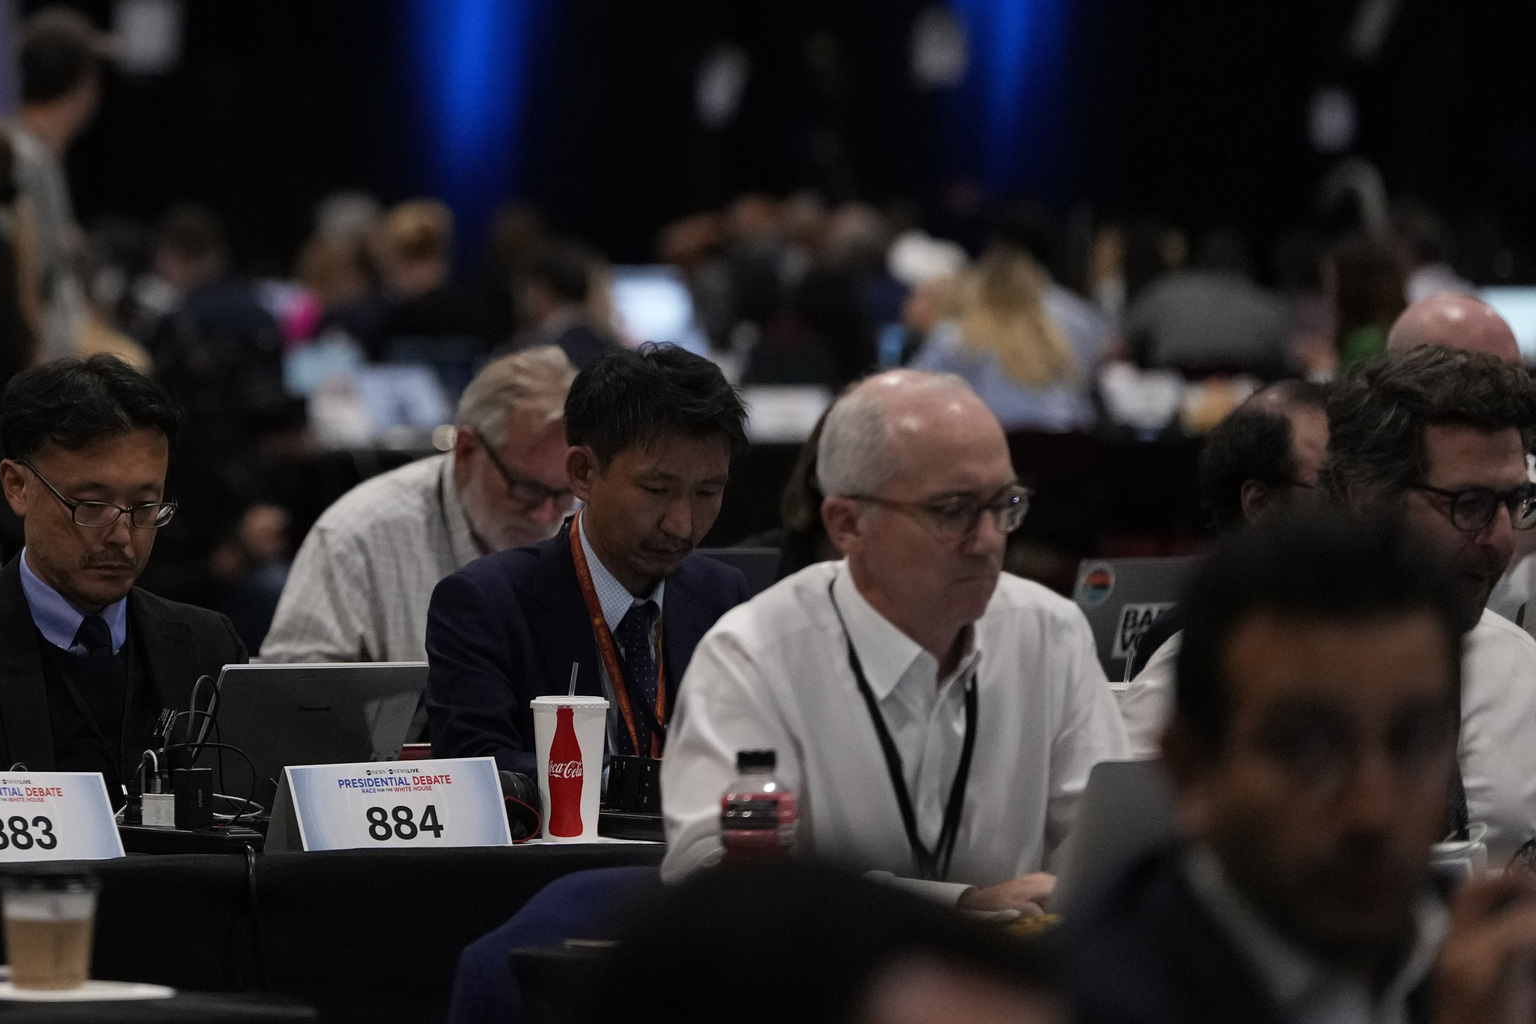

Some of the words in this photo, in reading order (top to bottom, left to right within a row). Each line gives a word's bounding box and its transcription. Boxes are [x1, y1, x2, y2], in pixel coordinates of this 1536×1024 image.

[337, 776, 411, 789] PRESIDENTIAL
[412, 774, 452, 786] DEBATE
[25, 787, 63, 797] DEBATE
[366, 804, 444, 842] 884
